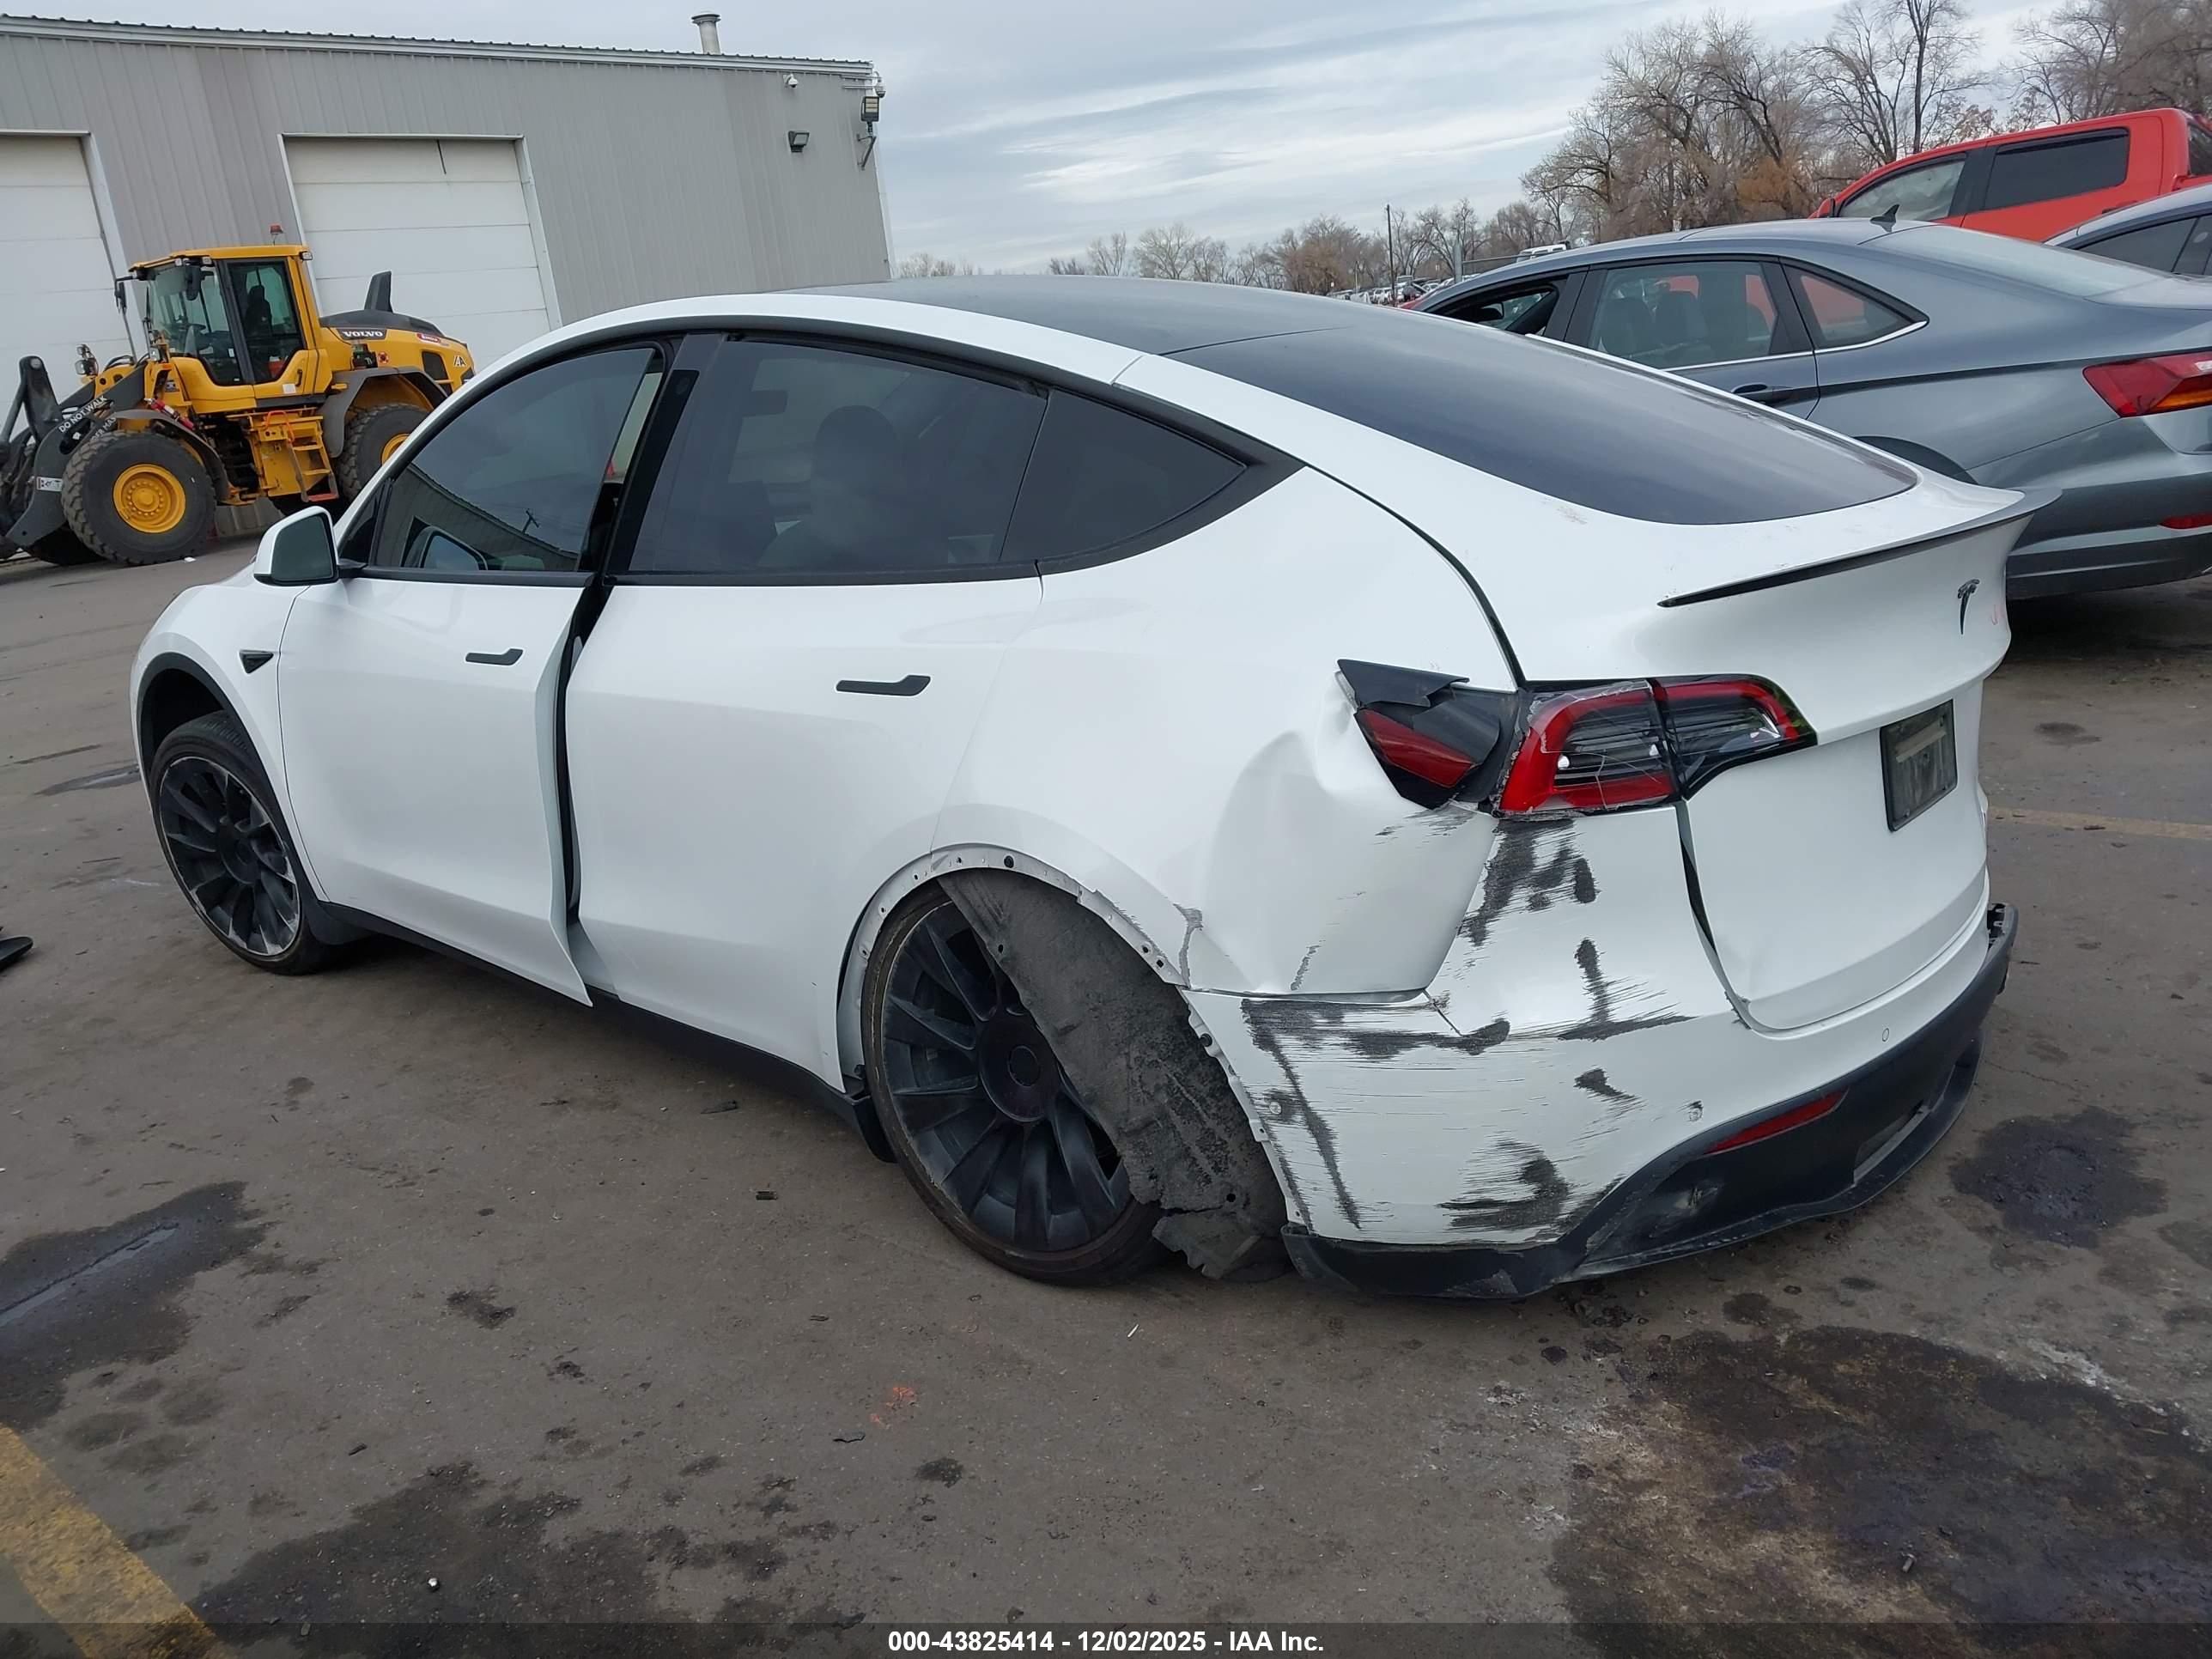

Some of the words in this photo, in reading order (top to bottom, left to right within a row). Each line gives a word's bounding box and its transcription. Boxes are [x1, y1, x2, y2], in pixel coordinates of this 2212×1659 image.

[58, 422, 71, 433] DO
[70, 409, 87, 424] NOT
[84, 395, 107, 412] WALK
[102, 417, 116, 430] MAS
